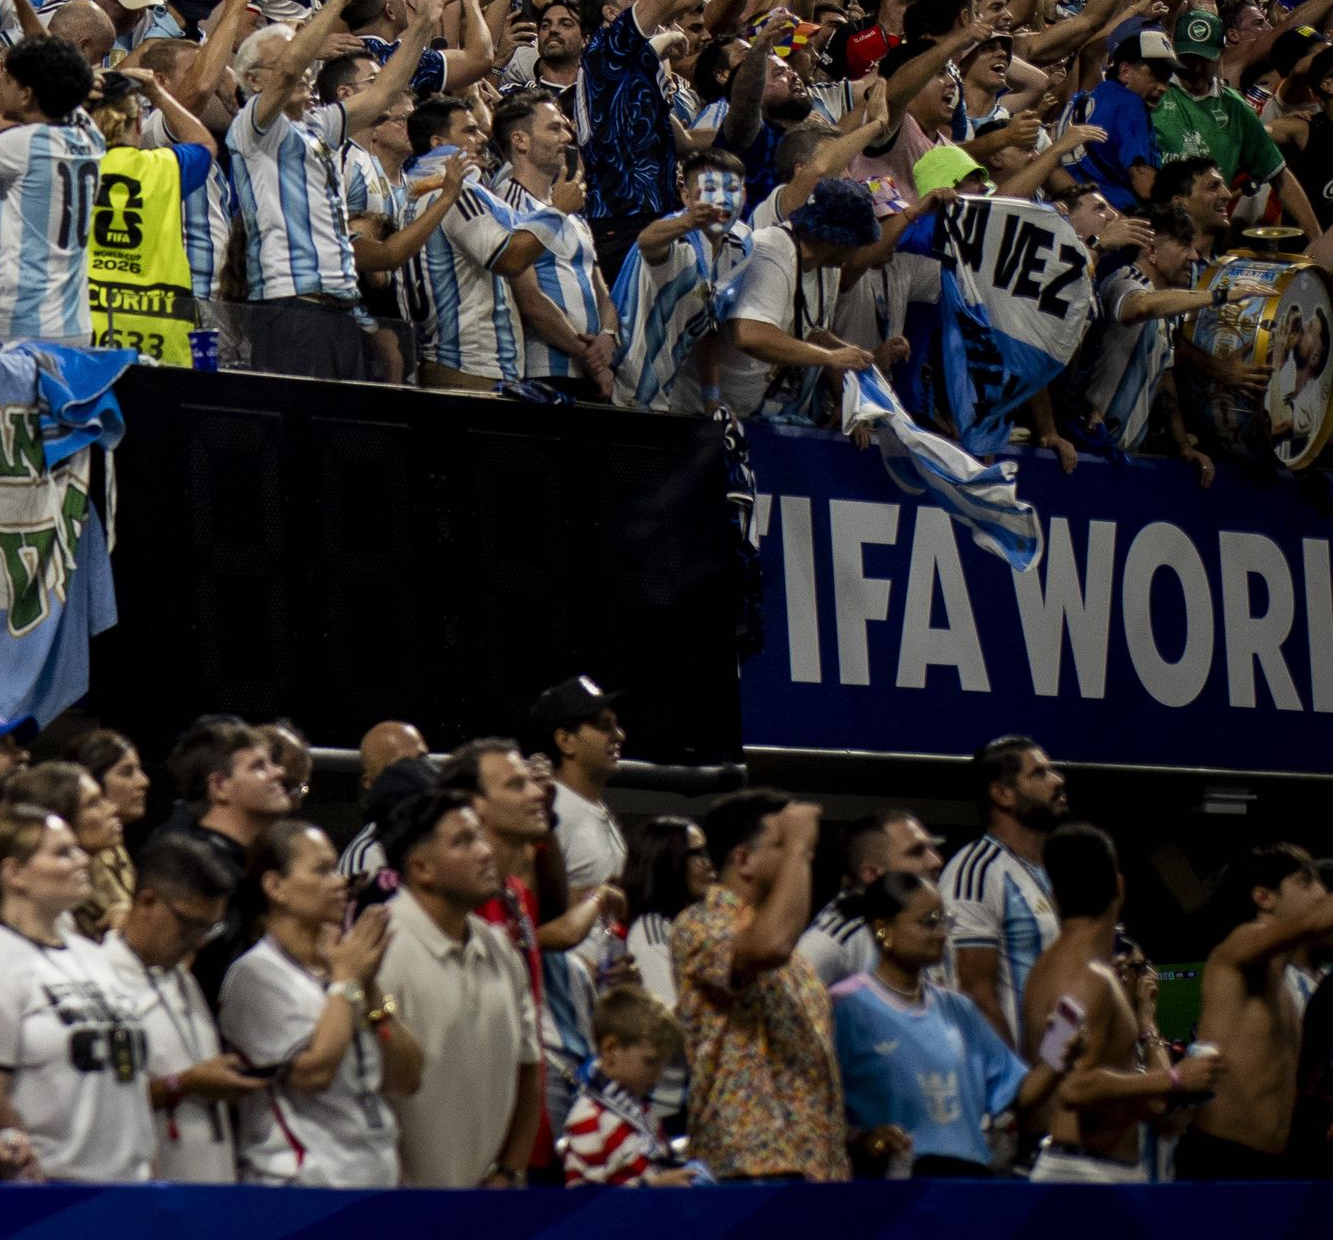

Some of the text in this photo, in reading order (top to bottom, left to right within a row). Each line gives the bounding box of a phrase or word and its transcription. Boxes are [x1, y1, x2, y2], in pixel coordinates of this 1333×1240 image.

[57, 162, 100, 249] 10
[106, 232, 131, 244] FIFA
[92, 260, 142, 274] 2026
[91, 328, 165, 361] 633
[755, 493, 992, 693] IFA
